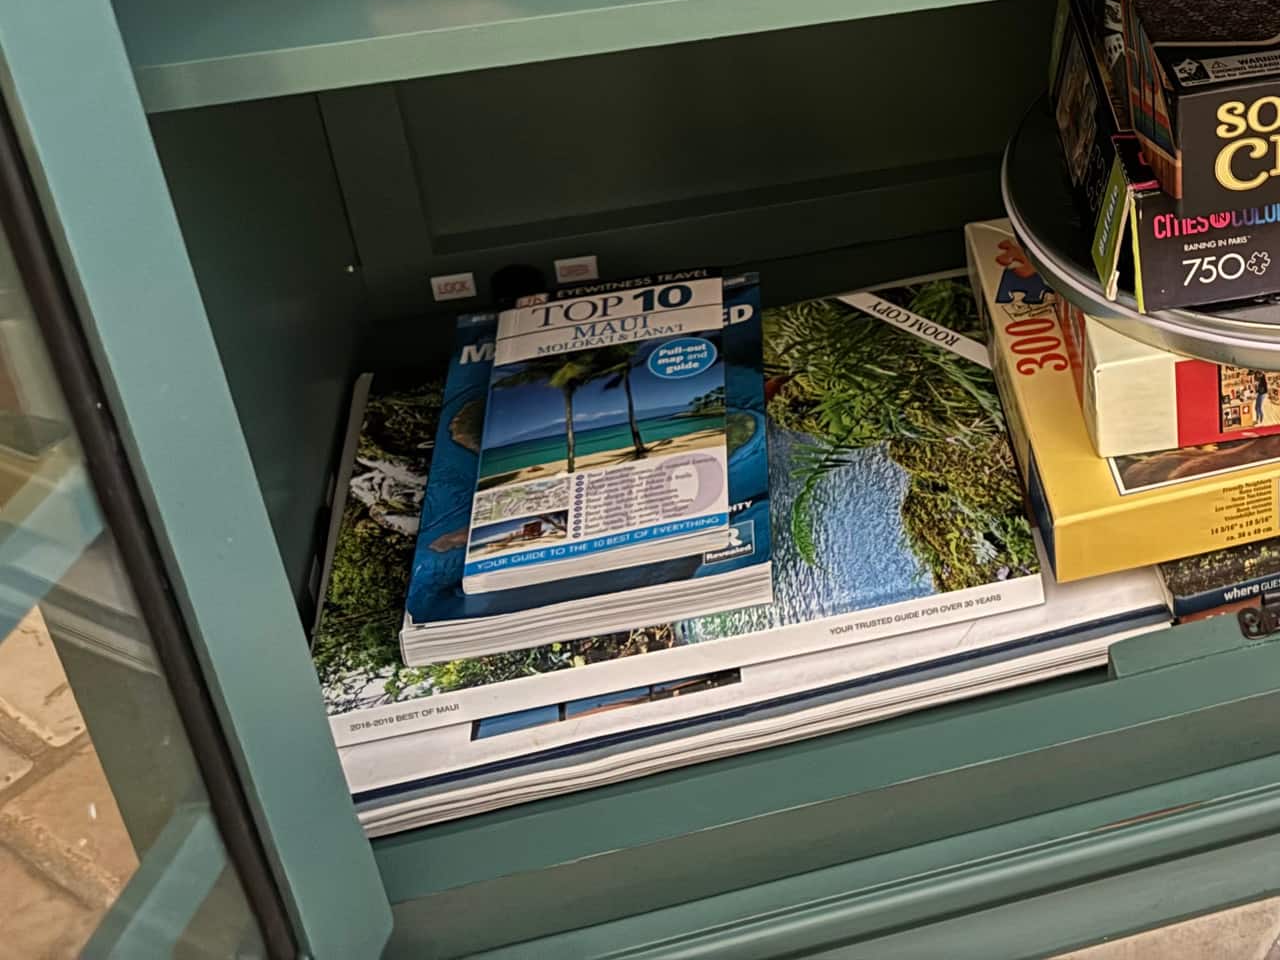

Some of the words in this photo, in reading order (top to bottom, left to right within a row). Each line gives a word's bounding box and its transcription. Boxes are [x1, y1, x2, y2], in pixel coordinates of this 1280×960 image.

[1183, 241, 1217, 251] RAINING
[1217, 239, 1227, 247] IN
[1228, 236, 1248, 245] PARIS
[556, 276, 651, 299] EYEWITNESS
[658, 269, 708, 282] TRAVEL
[1182, 253, 1245, 286] 750
[531, 297, 623, 328] TOP
[632, 284, 692, 313] 10
[870, 300, 912, 328] COPY
[573, 316, 650, 340] MAUI
[913, 317, 961, 349] ROOM
[657, 354, 684, 367] map
[687, 350, 708, 361] and
[659, 343, 708, 358] Pull-out
[1003, 318, 1069, 377] 300
[665, 360, 700, 375] guide
[475, 555, 508, 571] YOUR
[511, 548, 548, 565] GUIDE
[551, 547, 565, 558] TO
[569, 542, 588, 554] THE
[606, 534, 631, 547] BEST
[634, 530, 649, 540] OF
[653, 516, 720, 536] EVERYTHING
[1223, 583, 1260, 602] where
[829, 624, 854, 637] YOUR
[854, 616, 893, 632] TRUSTED
[893, 609, 920, 624] GUIDE
[921, 605, 939, 618] FOR
[939, 600, 963, 614] OVER
[963, 598, 975, 608] 30
[975, 592, 1002, 606] YEARS
[350, 713, 396, 733] 2018-2019
[396, 709, 420, 724] BEST
[421, 706, 434, 718] OF
[435, 703, 461, 716] MAUI
